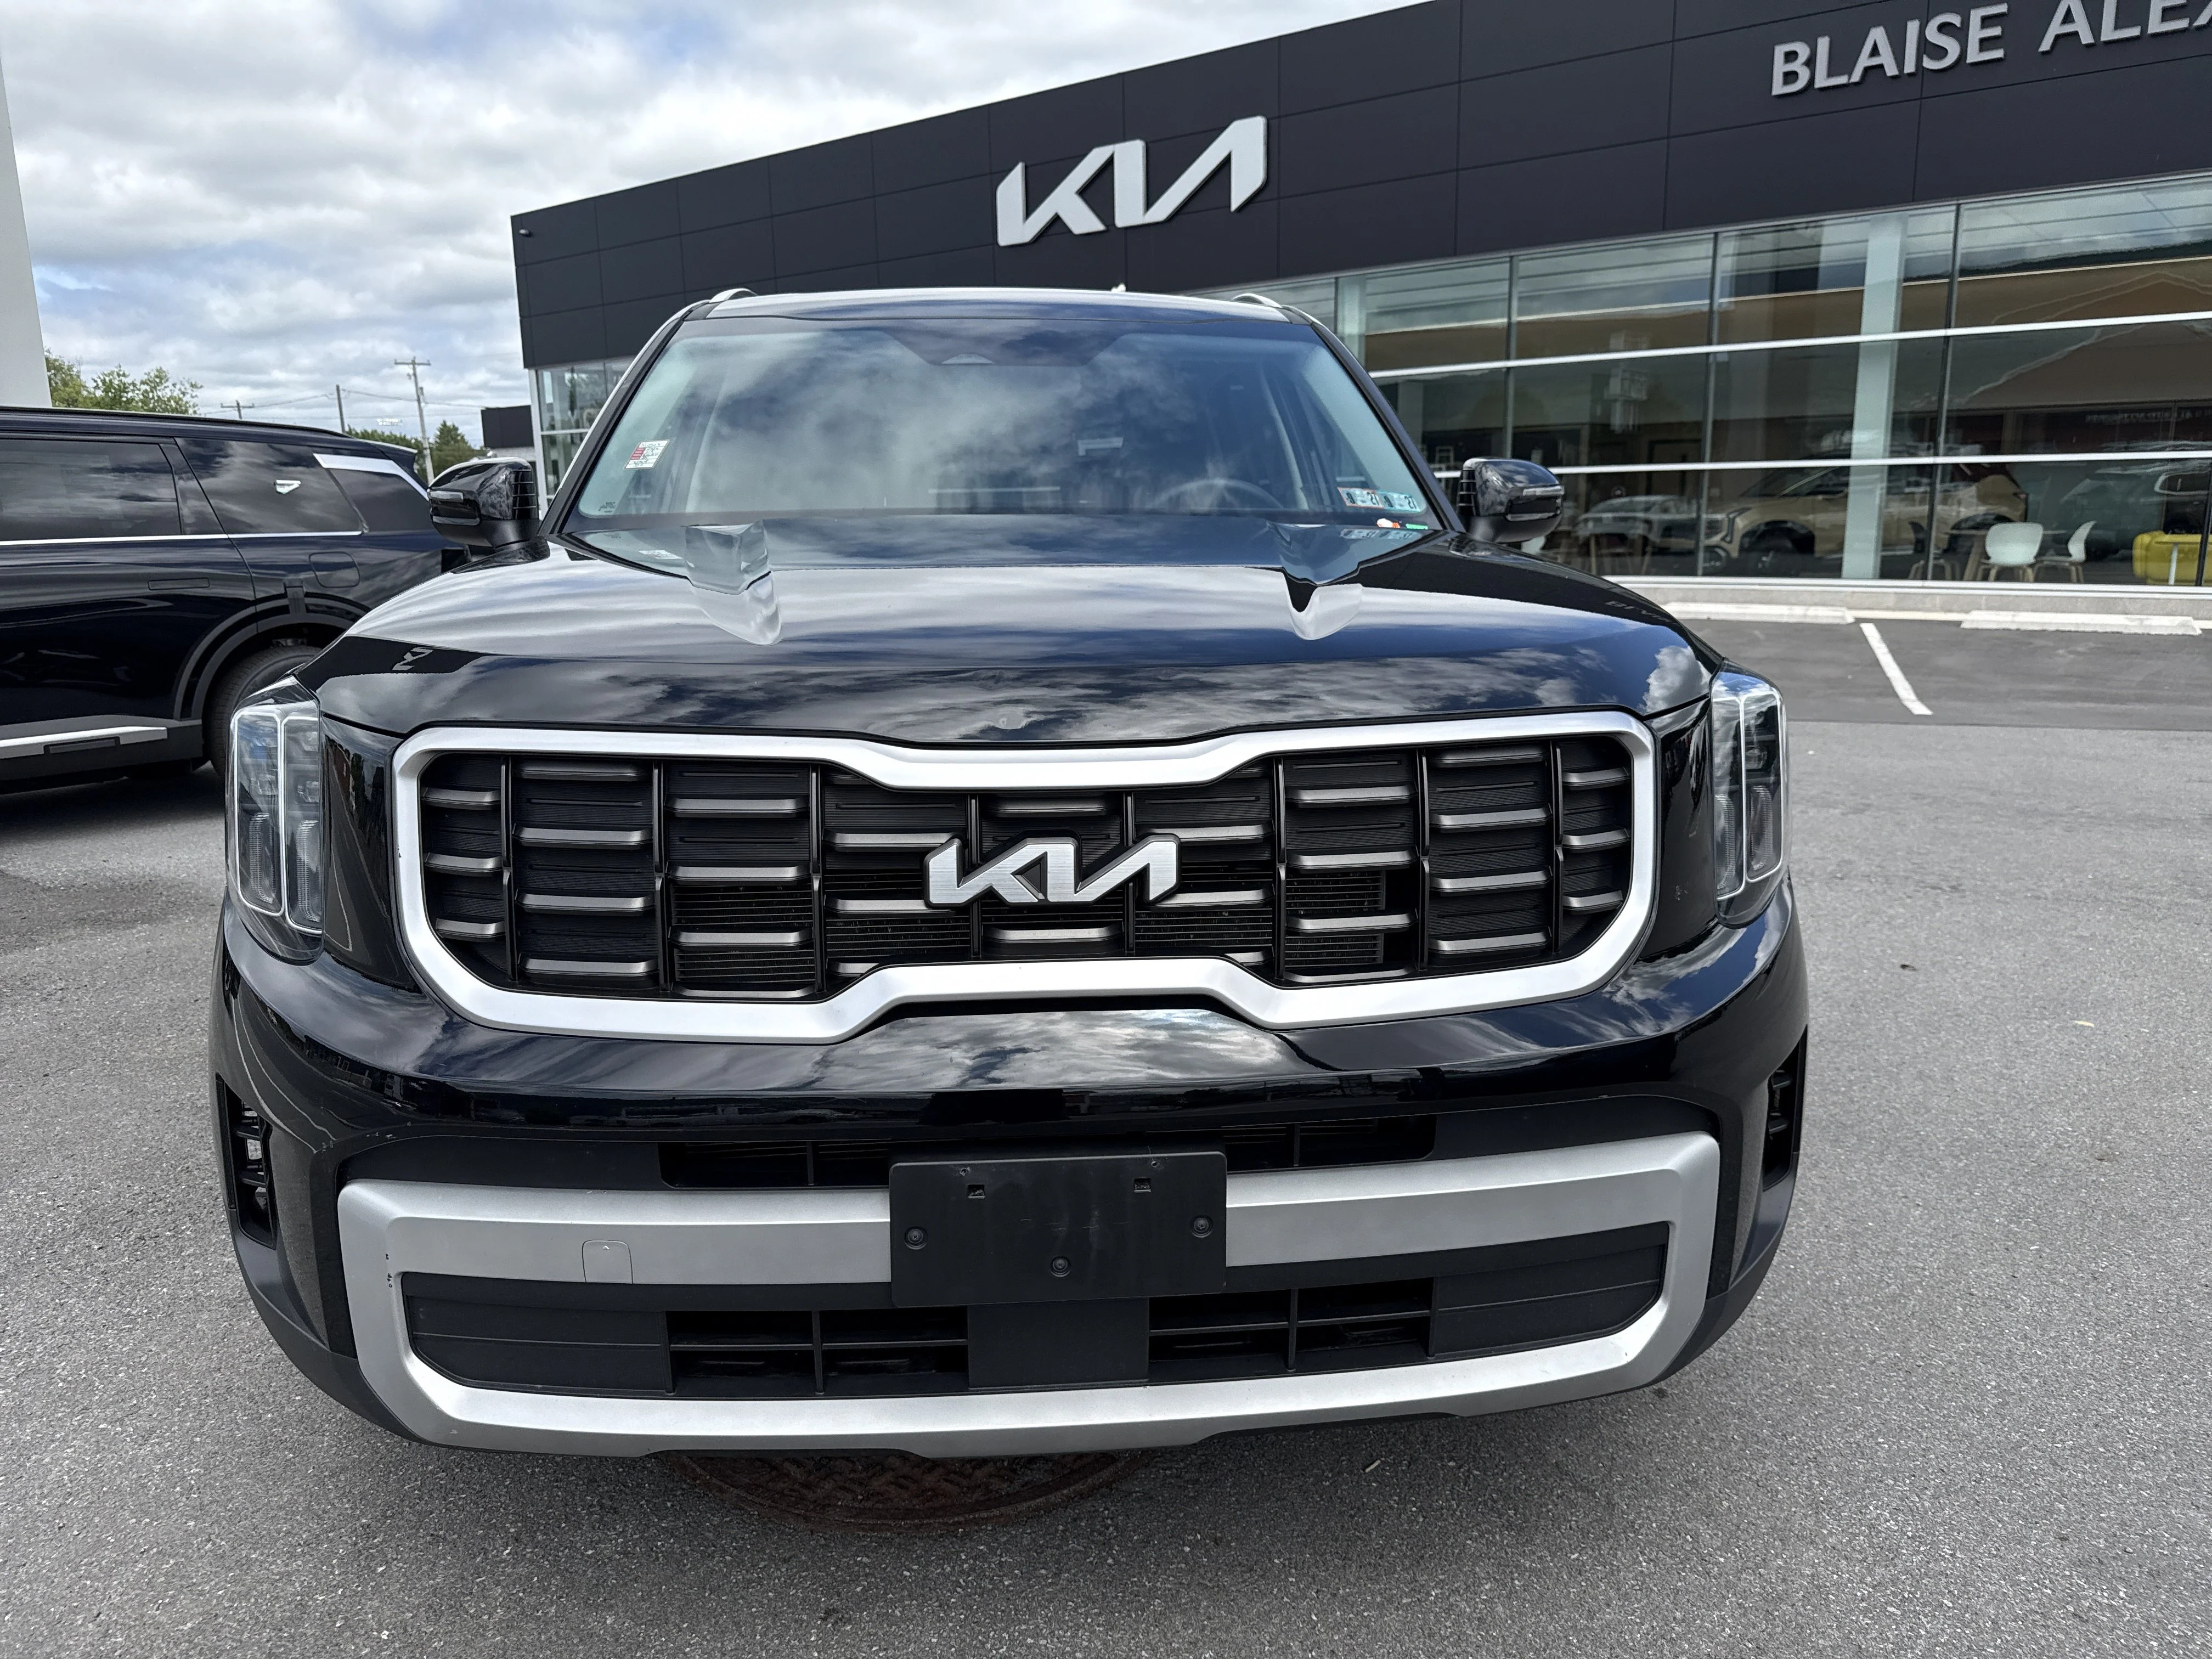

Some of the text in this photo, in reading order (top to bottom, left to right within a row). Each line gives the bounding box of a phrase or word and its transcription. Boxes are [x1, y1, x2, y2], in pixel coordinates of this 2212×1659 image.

[1771, 0, 2212, 97] BLAISE ALE
[996, 115, 1268, 247] KIA
[925, 836, 1180, 905] KIA
